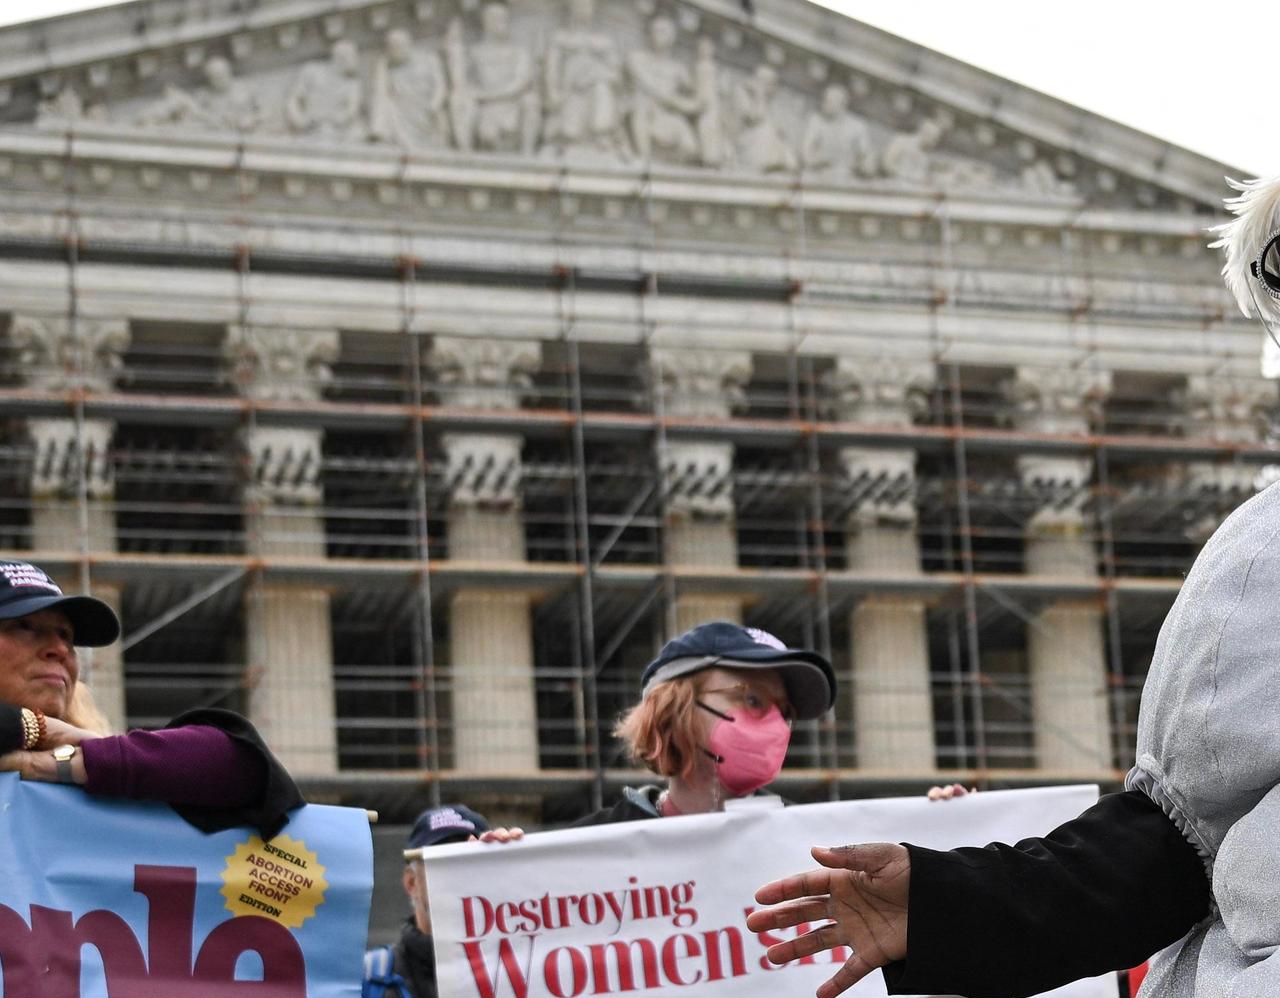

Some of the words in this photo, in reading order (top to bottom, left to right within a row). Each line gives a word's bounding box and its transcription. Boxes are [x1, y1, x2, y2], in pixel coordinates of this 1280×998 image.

[263, 843, 308, 869] SPECIAL
[245, 854, 314, 888] ABORTION
[249, 868, 301, 896] ACCESS
[239, 893, 282, 917] EDITION
[248, 880, 292, 904] FRONT
[461, 876, 698, 938] Destroying
